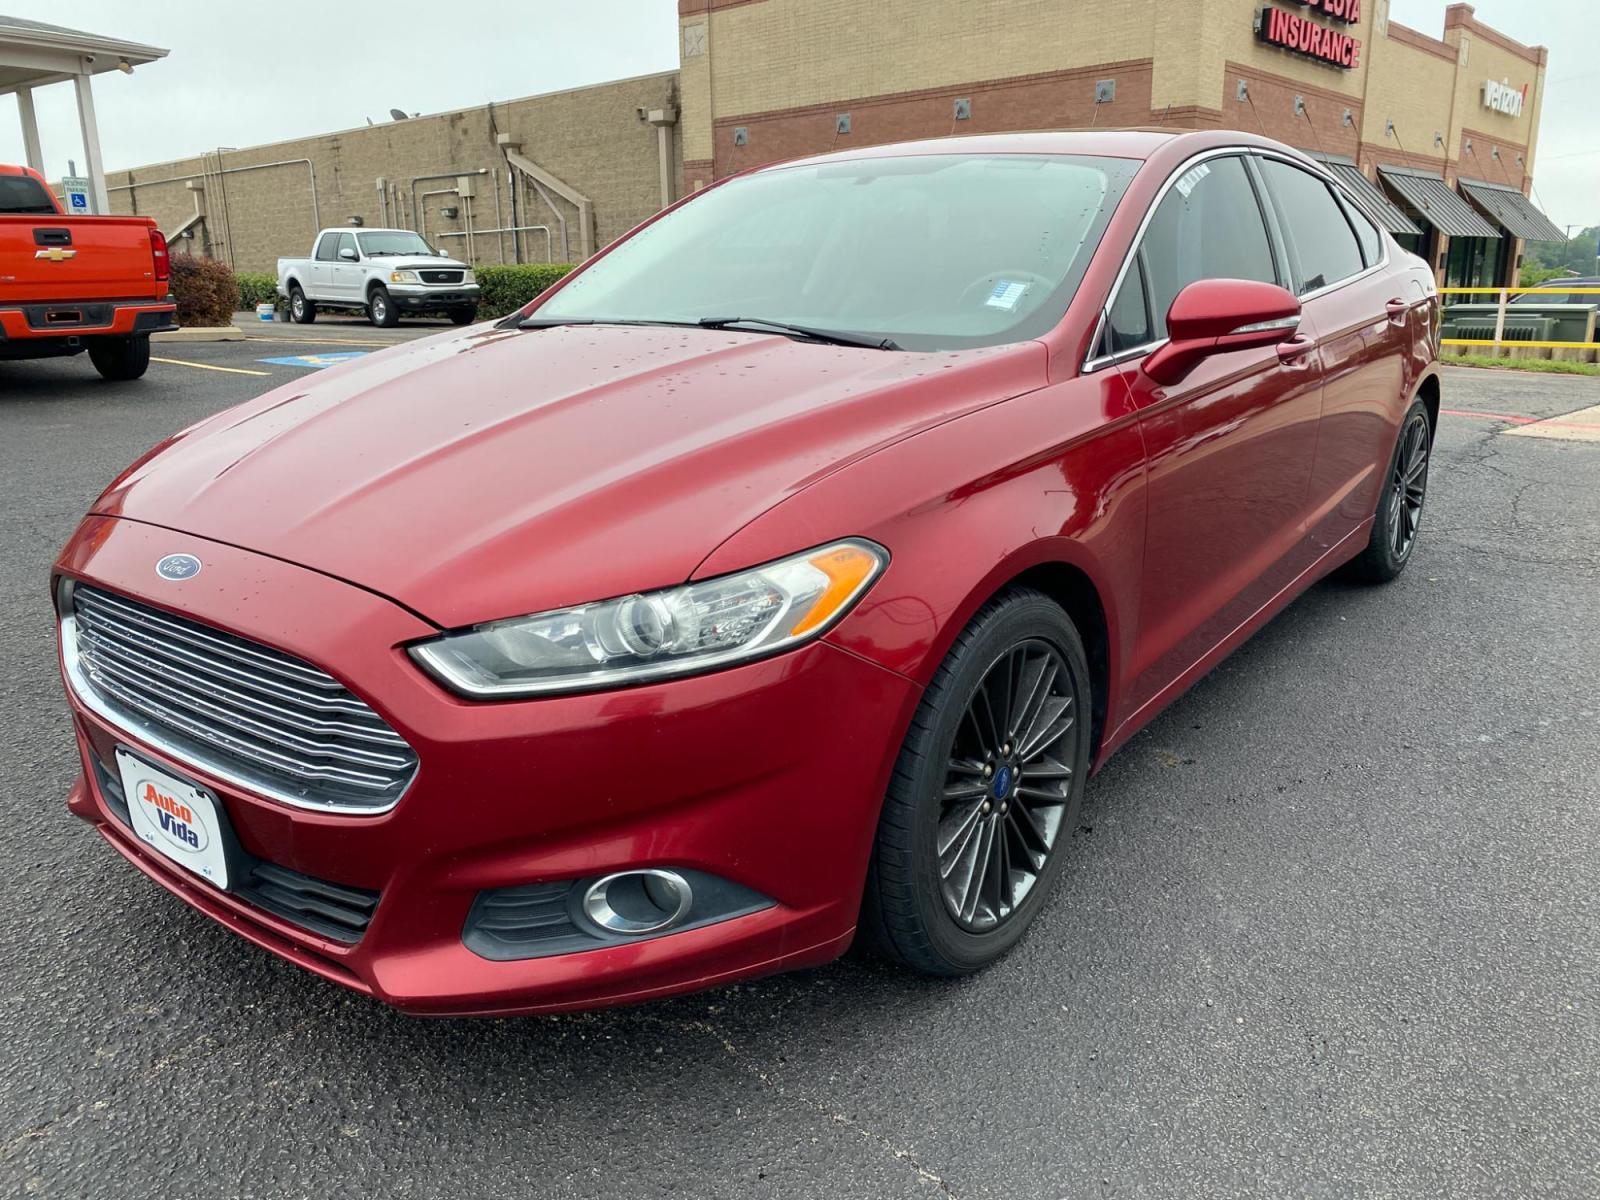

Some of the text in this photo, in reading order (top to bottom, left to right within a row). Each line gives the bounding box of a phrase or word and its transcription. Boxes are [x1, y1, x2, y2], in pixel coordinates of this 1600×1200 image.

[1269, 7, 1360, 68] INSURANCE
[1486, 77, 1521, 118] verizon
[163, 558, 192, 575] Ford
[143, 783, 193, 825] Auto
[156, 808, 199, 849] Vida
